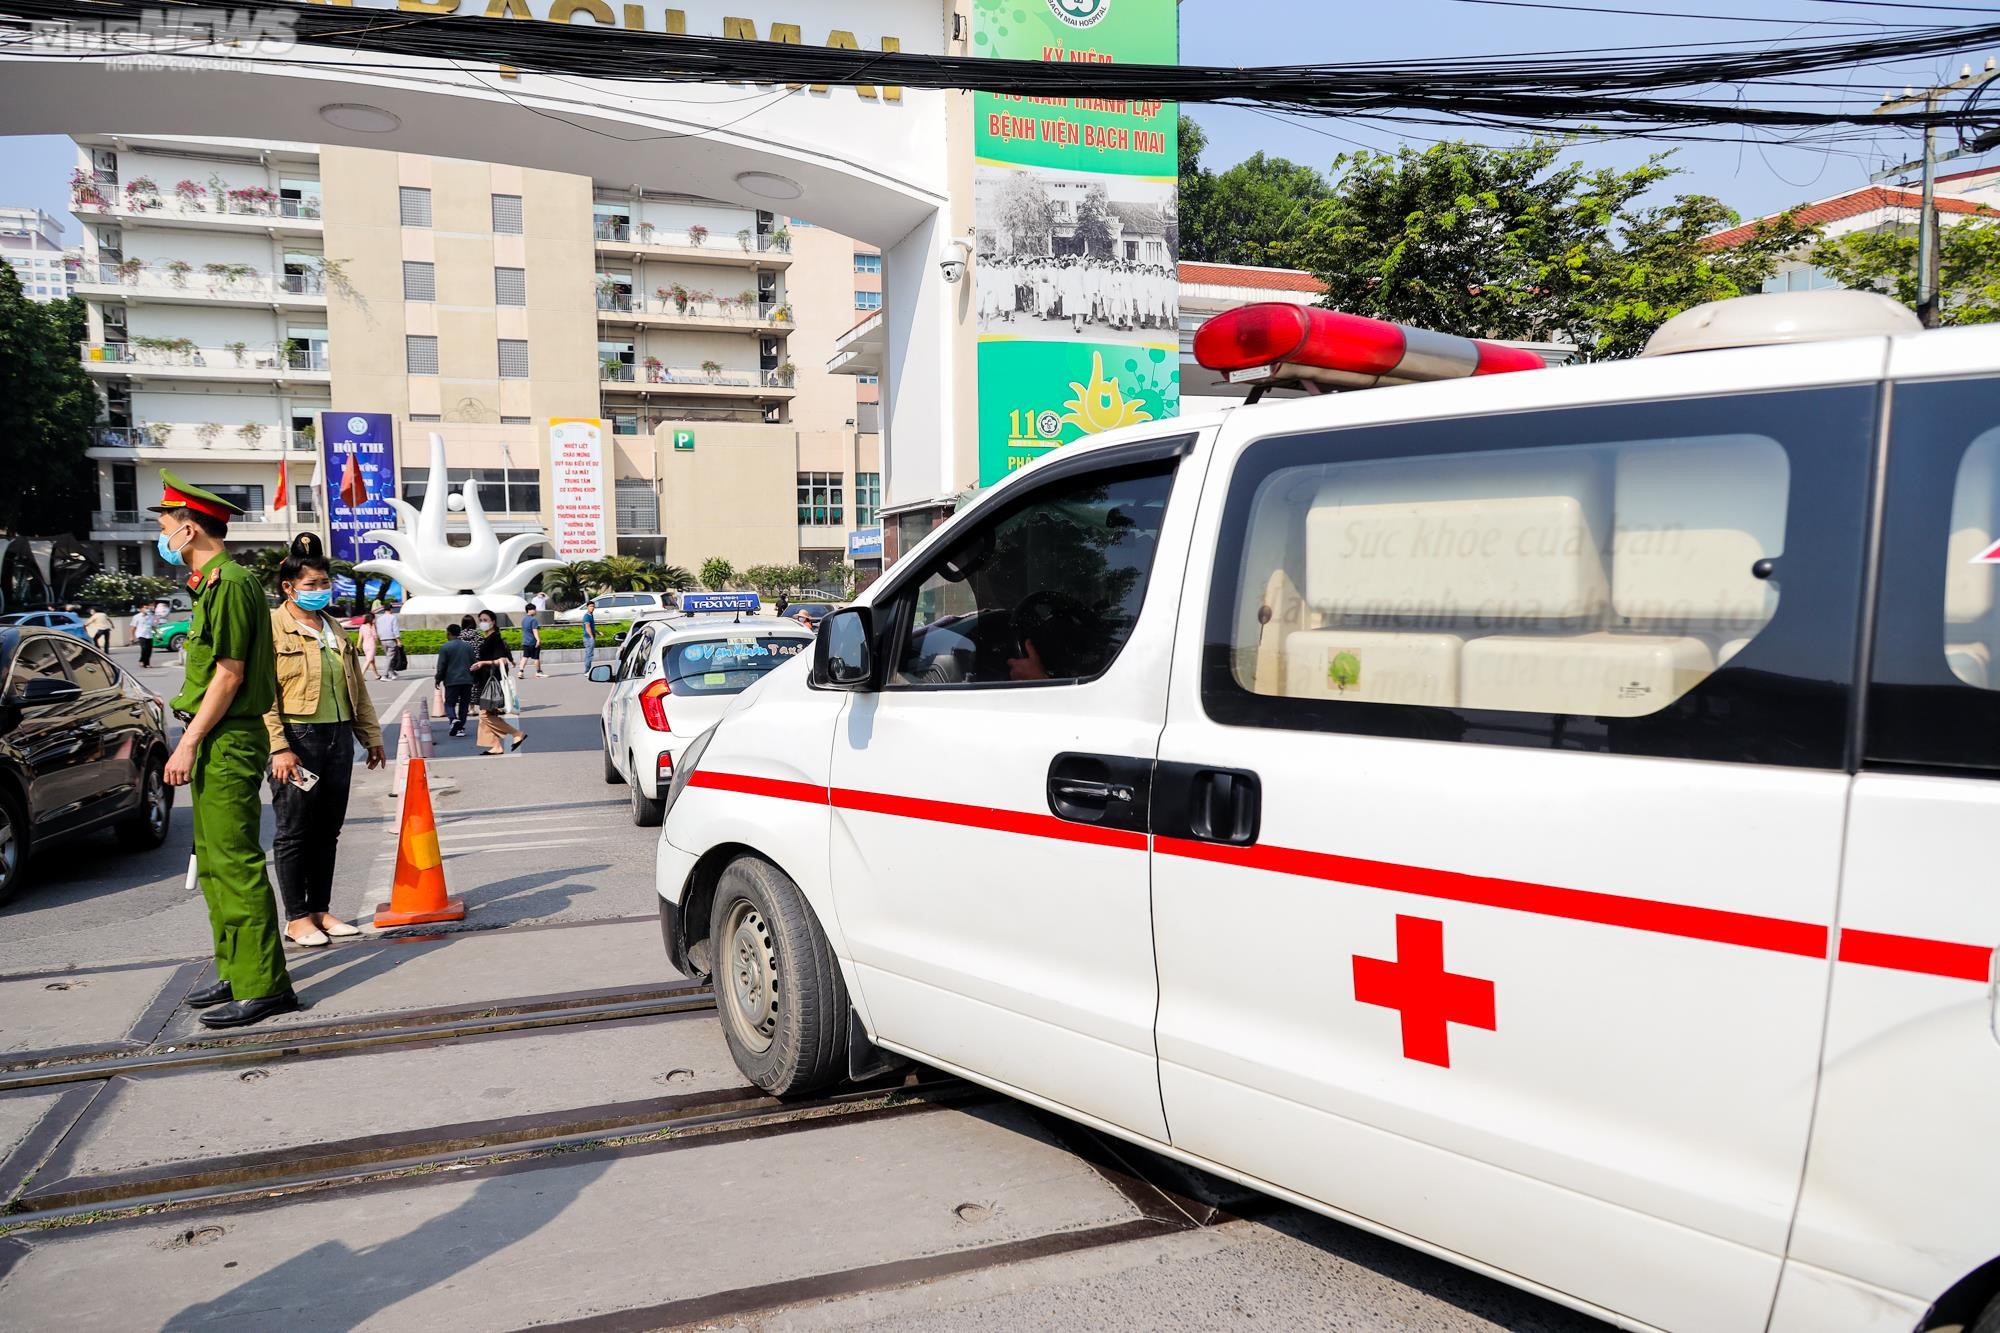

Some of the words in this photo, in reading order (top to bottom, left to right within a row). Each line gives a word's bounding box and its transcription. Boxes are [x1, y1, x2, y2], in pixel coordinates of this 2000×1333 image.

[1079, 6, 1107, 27] HOSPITAL
[989, 111, 1036, 143] BỆNH
[1040, 118, 1080, 149] VIỆN
[1084, 124, 1129, 153] BẠCH
[1133, 130, 1165, 154] MAI
[678, 432, 689, 447] P
[692, 600, 723, 609] TAXI
[768, 643, 804, 656] Taxi
